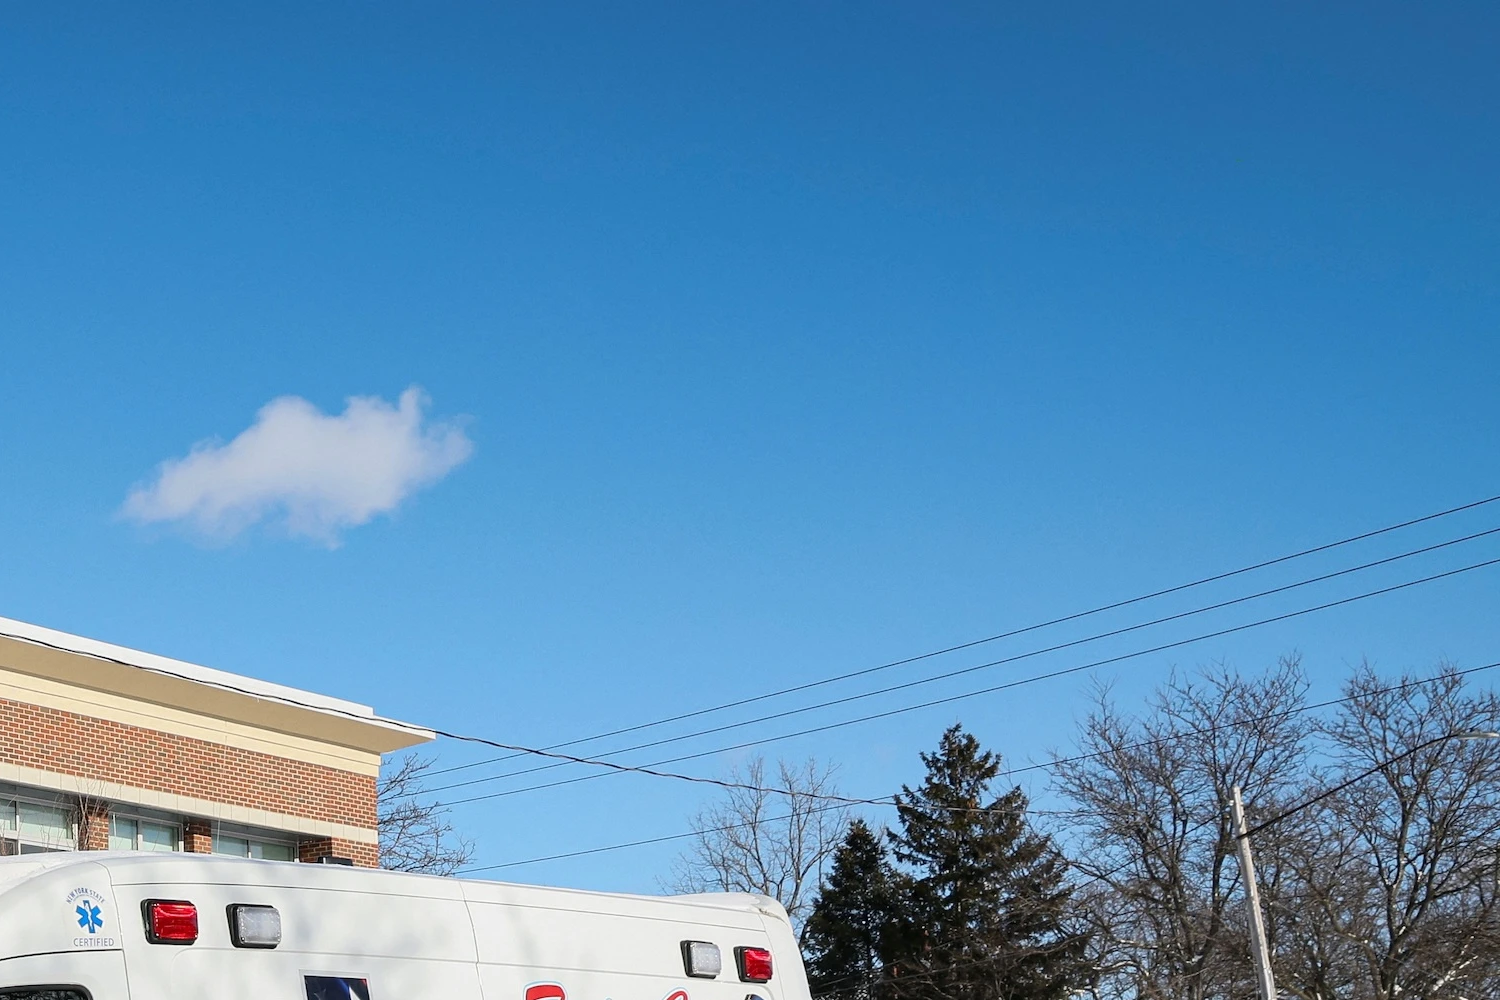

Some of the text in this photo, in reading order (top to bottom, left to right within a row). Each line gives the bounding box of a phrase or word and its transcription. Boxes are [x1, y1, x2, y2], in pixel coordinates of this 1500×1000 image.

[66, 887, 105, 904] NEW YORK STATE
[73, 937, 114, 947] CERTIFIED
